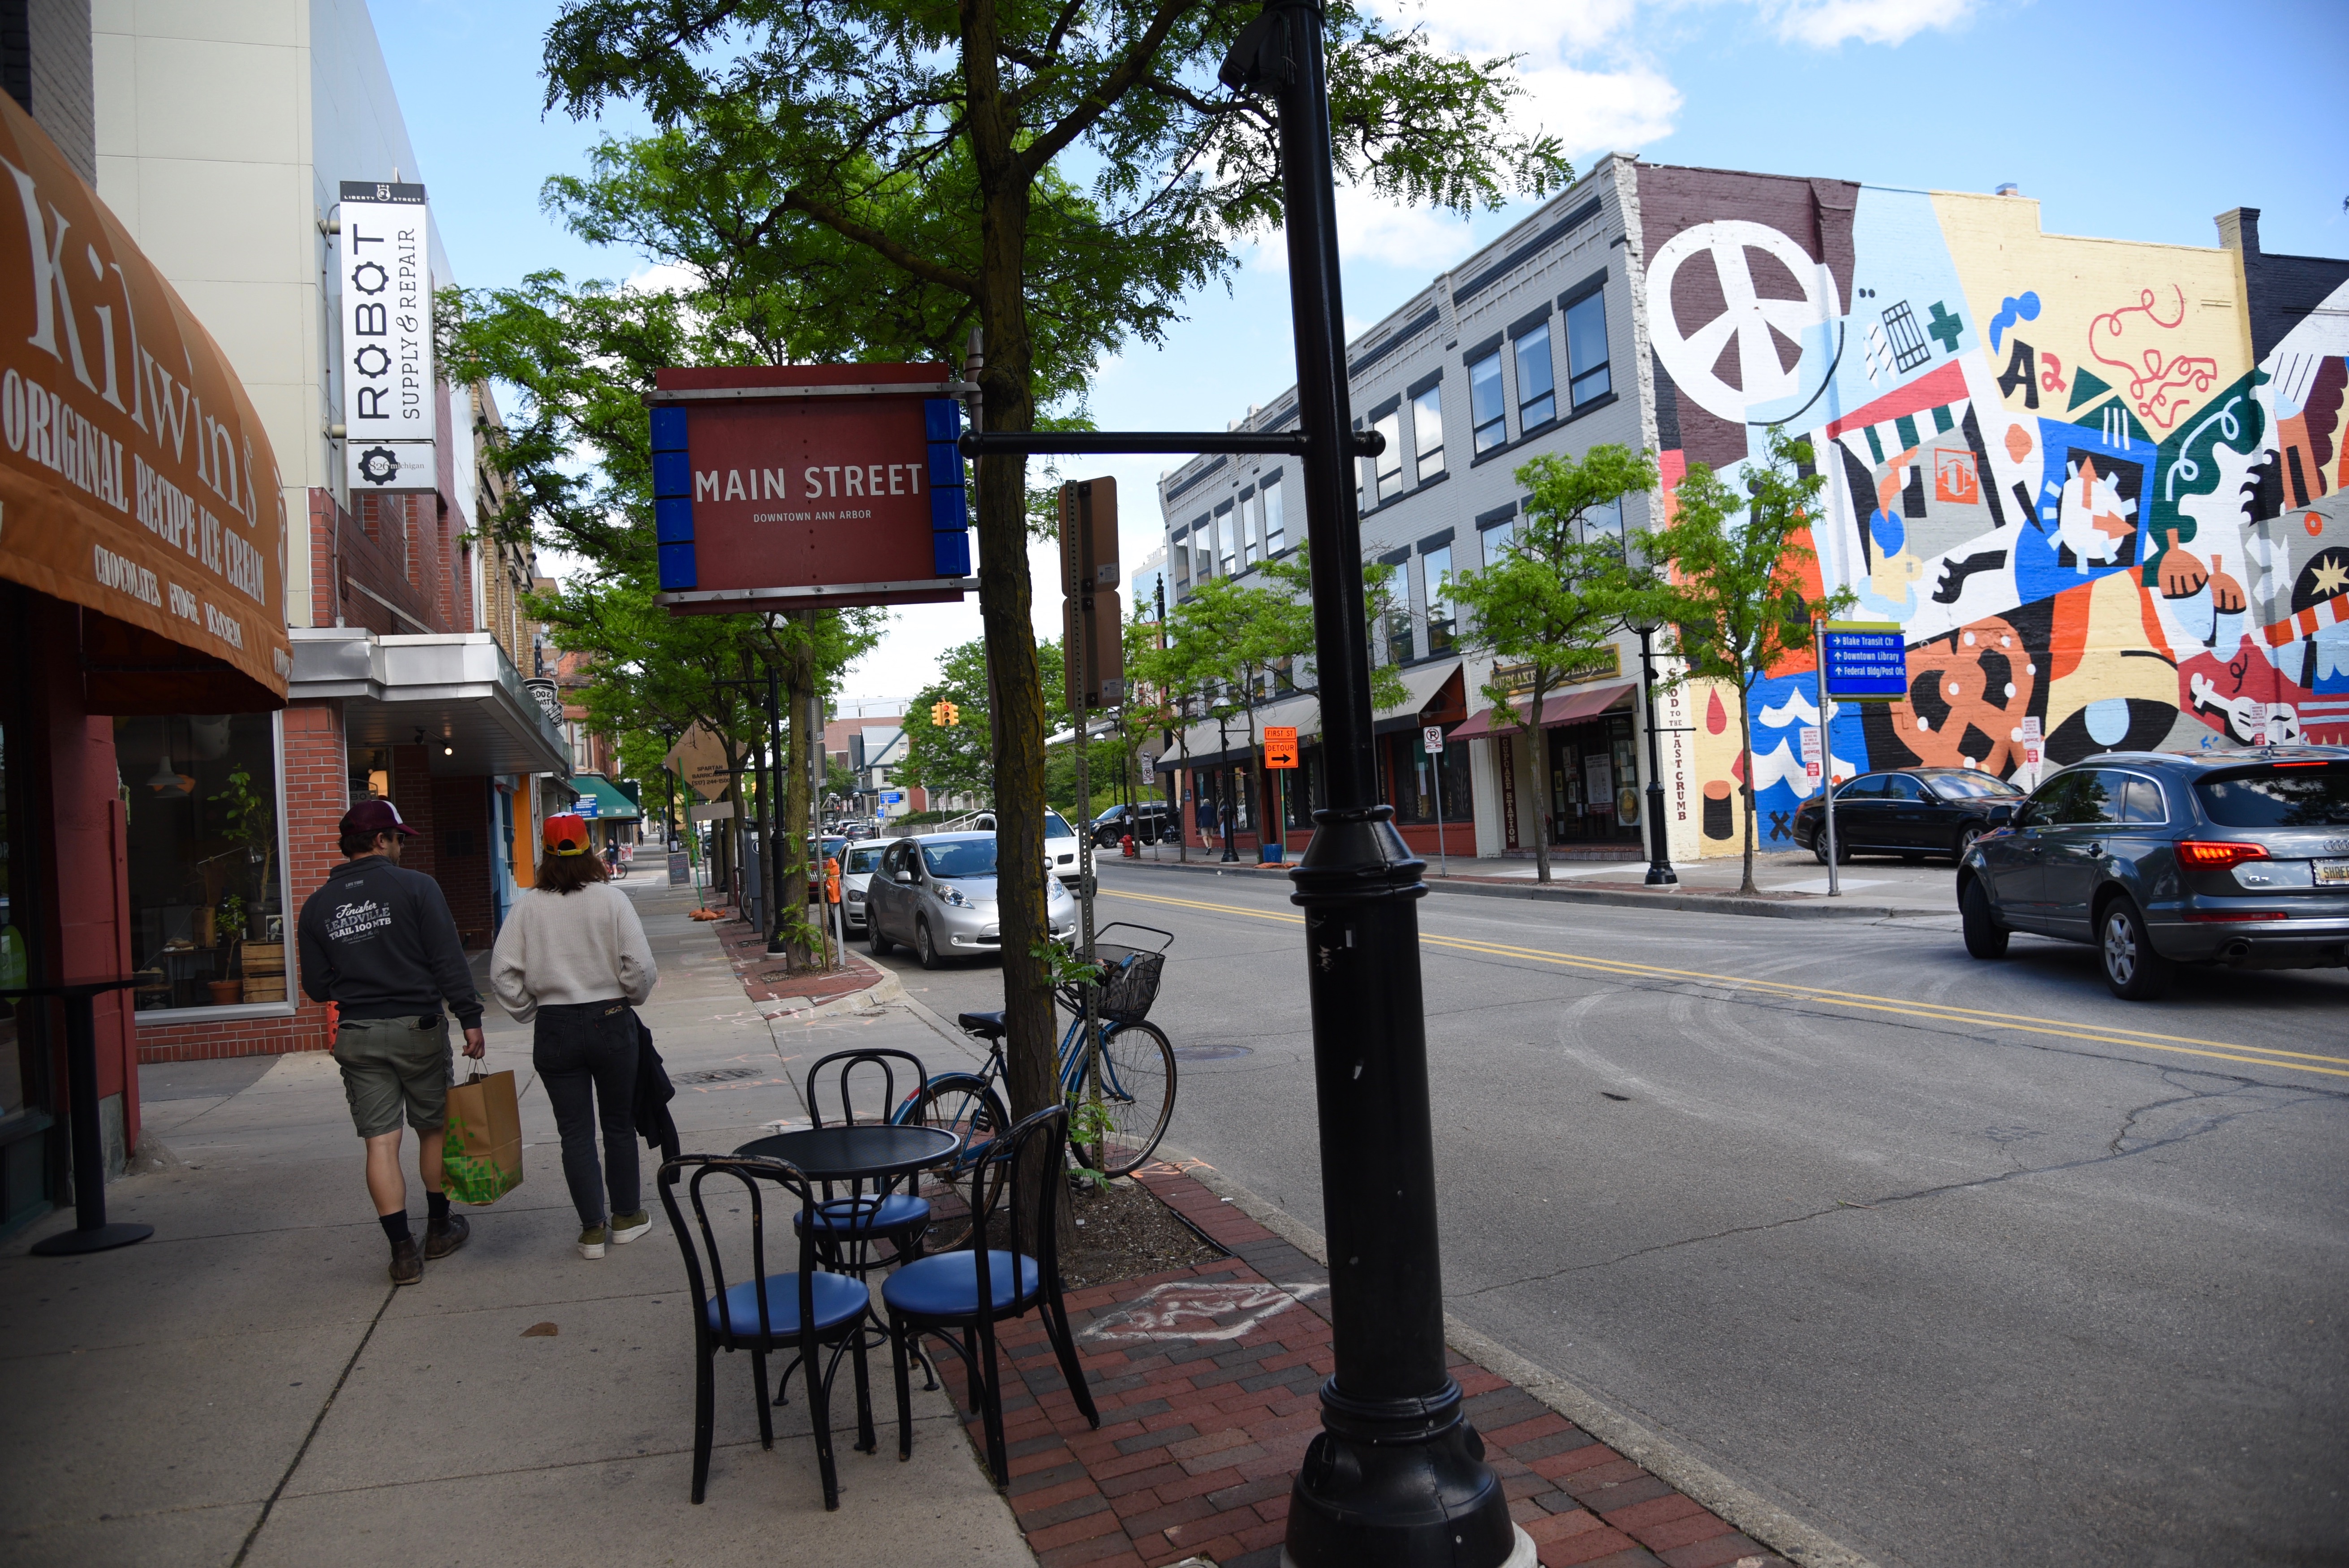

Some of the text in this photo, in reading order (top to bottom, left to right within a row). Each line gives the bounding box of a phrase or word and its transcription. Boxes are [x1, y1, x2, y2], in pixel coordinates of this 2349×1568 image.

[351, 224, 392, 419] ROBOT
[396, 228, 420, 419] SUPPLY & REPAIR
[2, 368, 129, 513] ORIGINAL
[134, 453, 197, 558] RECIPE
[199, 504, 222, 576] ICE
[225, 526, 265, 607] CREAM
[695, 464, 922, 502] MAIN STREET
[754, 510, 872, 523] DOWNTOWN ANN ARBOR
[95, 544, 161, 608] CHOCOLATES
[168, 581, 200, 625] FUDGE
[1842, 636, 1894, 646] Blake Transit Ctr
[1843, 651, 1899, 663] Downtown Library
[1844, 666, 1905, 678] Federal Bldg/Post Ofc
[1502, 739, 1511, 789] CUPCAKE
[1673, 731, 1682, 768] LAST
[1675, 772, 1686, 820] CRUMB
[1506, 792, 1516, 843] STATION
[325, 907, 391, 933] LEADVILLE
[336, 900, 377, 919] Finisher
[329, 918, 392, 940] TRAIL 100 MTB
